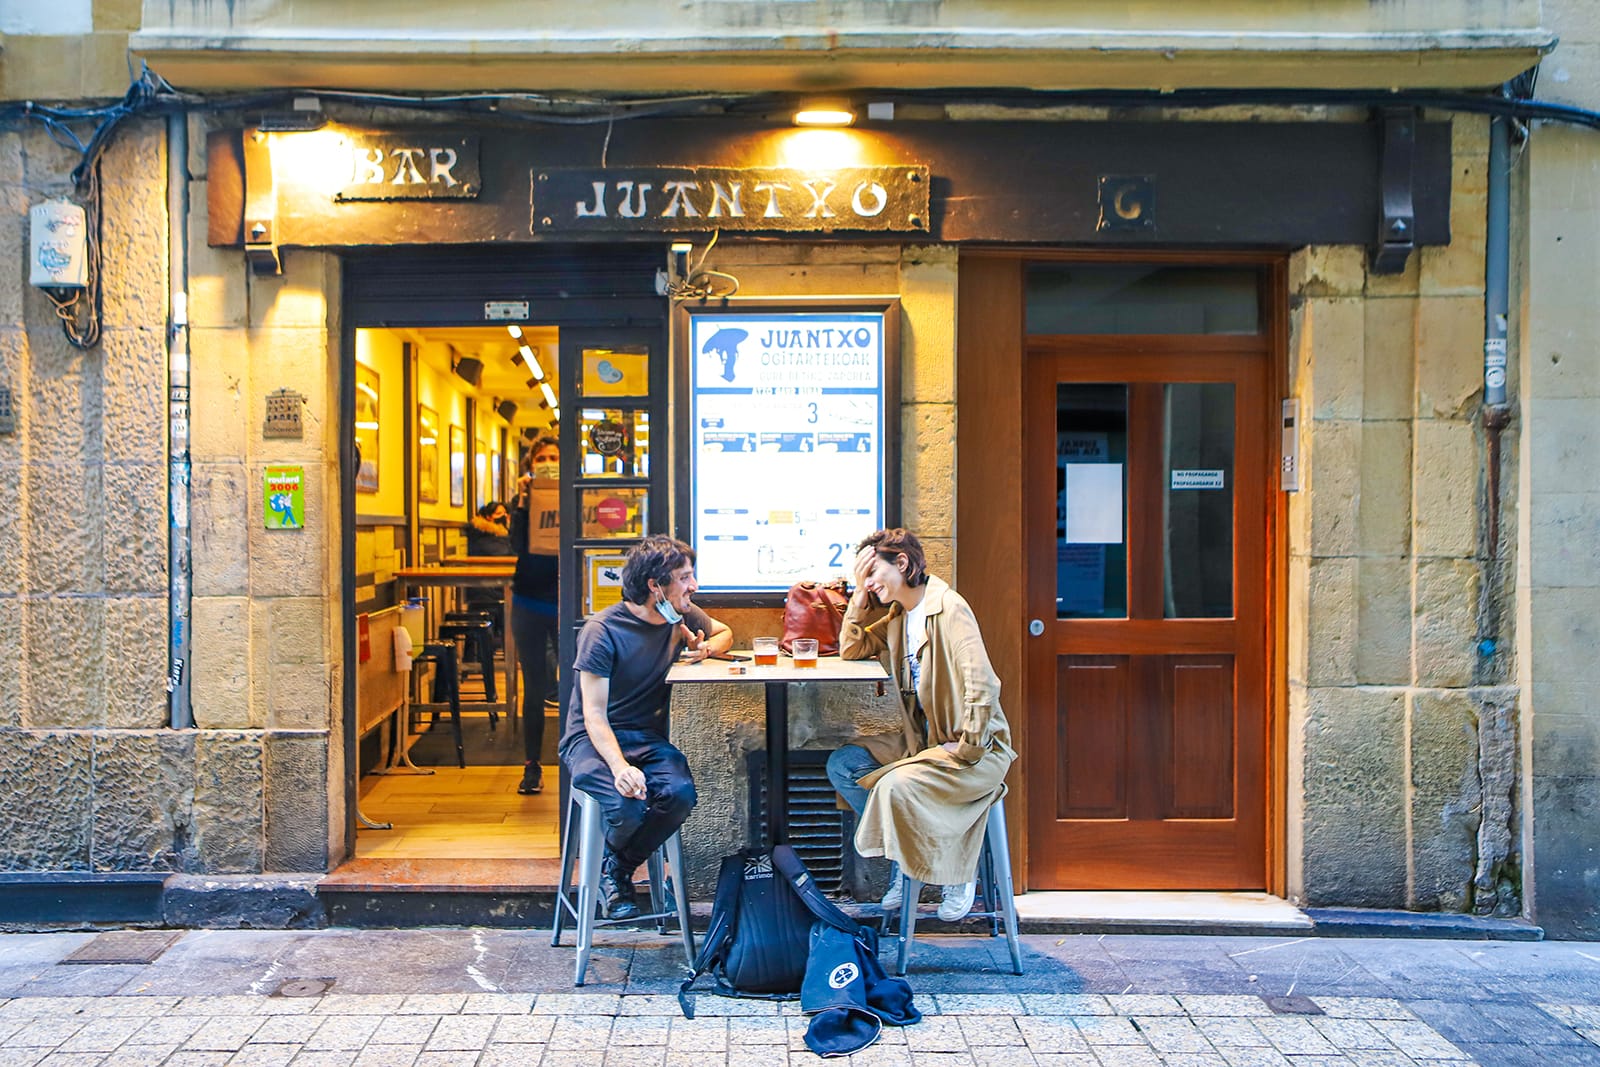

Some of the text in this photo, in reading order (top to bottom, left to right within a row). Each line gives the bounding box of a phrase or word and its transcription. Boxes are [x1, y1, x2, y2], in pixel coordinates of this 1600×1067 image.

[351, 148, 458, 187] BAR
[576, 180, 888, 218] JUANTXO
[760, 328, 871, 348] JUANTXO
